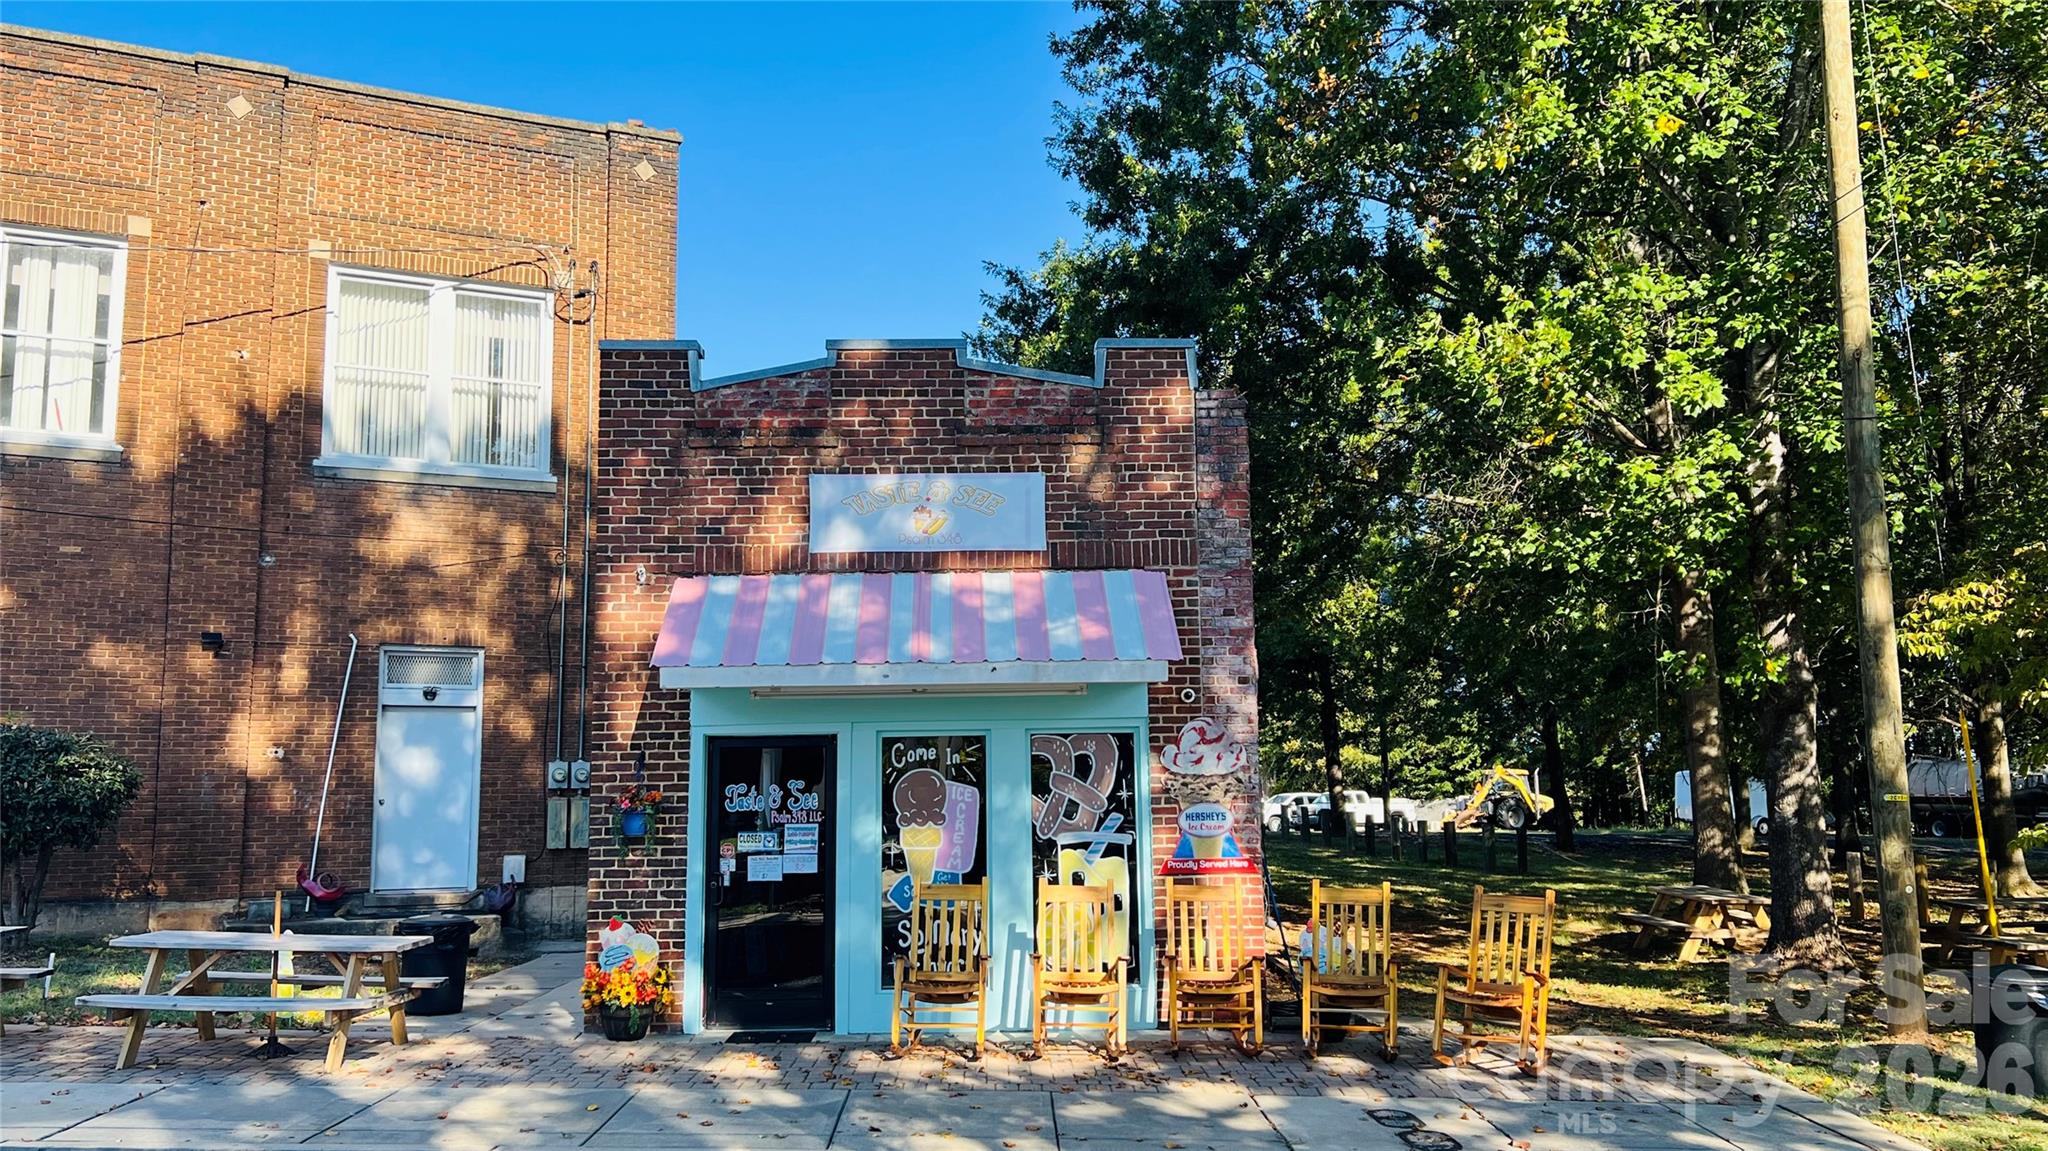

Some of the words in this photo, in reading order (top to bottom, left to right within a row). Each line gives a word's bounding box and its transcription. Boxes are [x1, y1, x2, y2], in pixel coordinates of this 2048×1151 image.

[841, 480, 921, 516] TASTE
[952, 484, 1006, 517] SEE
[891, 743, 937, 768] Come
[945, 748, 960, 765] In
[725, 783, 764, 812] Taste
[768, 783, 783, 809] &
[787, 779, 819, 811] See
[951, 786, 974, 801] ICE
[771, 810, 791, 823] Psalm
[1185, 812, 1227, 821] HERSHEY'S
[739, 833, 763, 844] CLOSED
[946, 804, 967, 870] CREAM
[1167, 861, 1198, 870] Proudly
